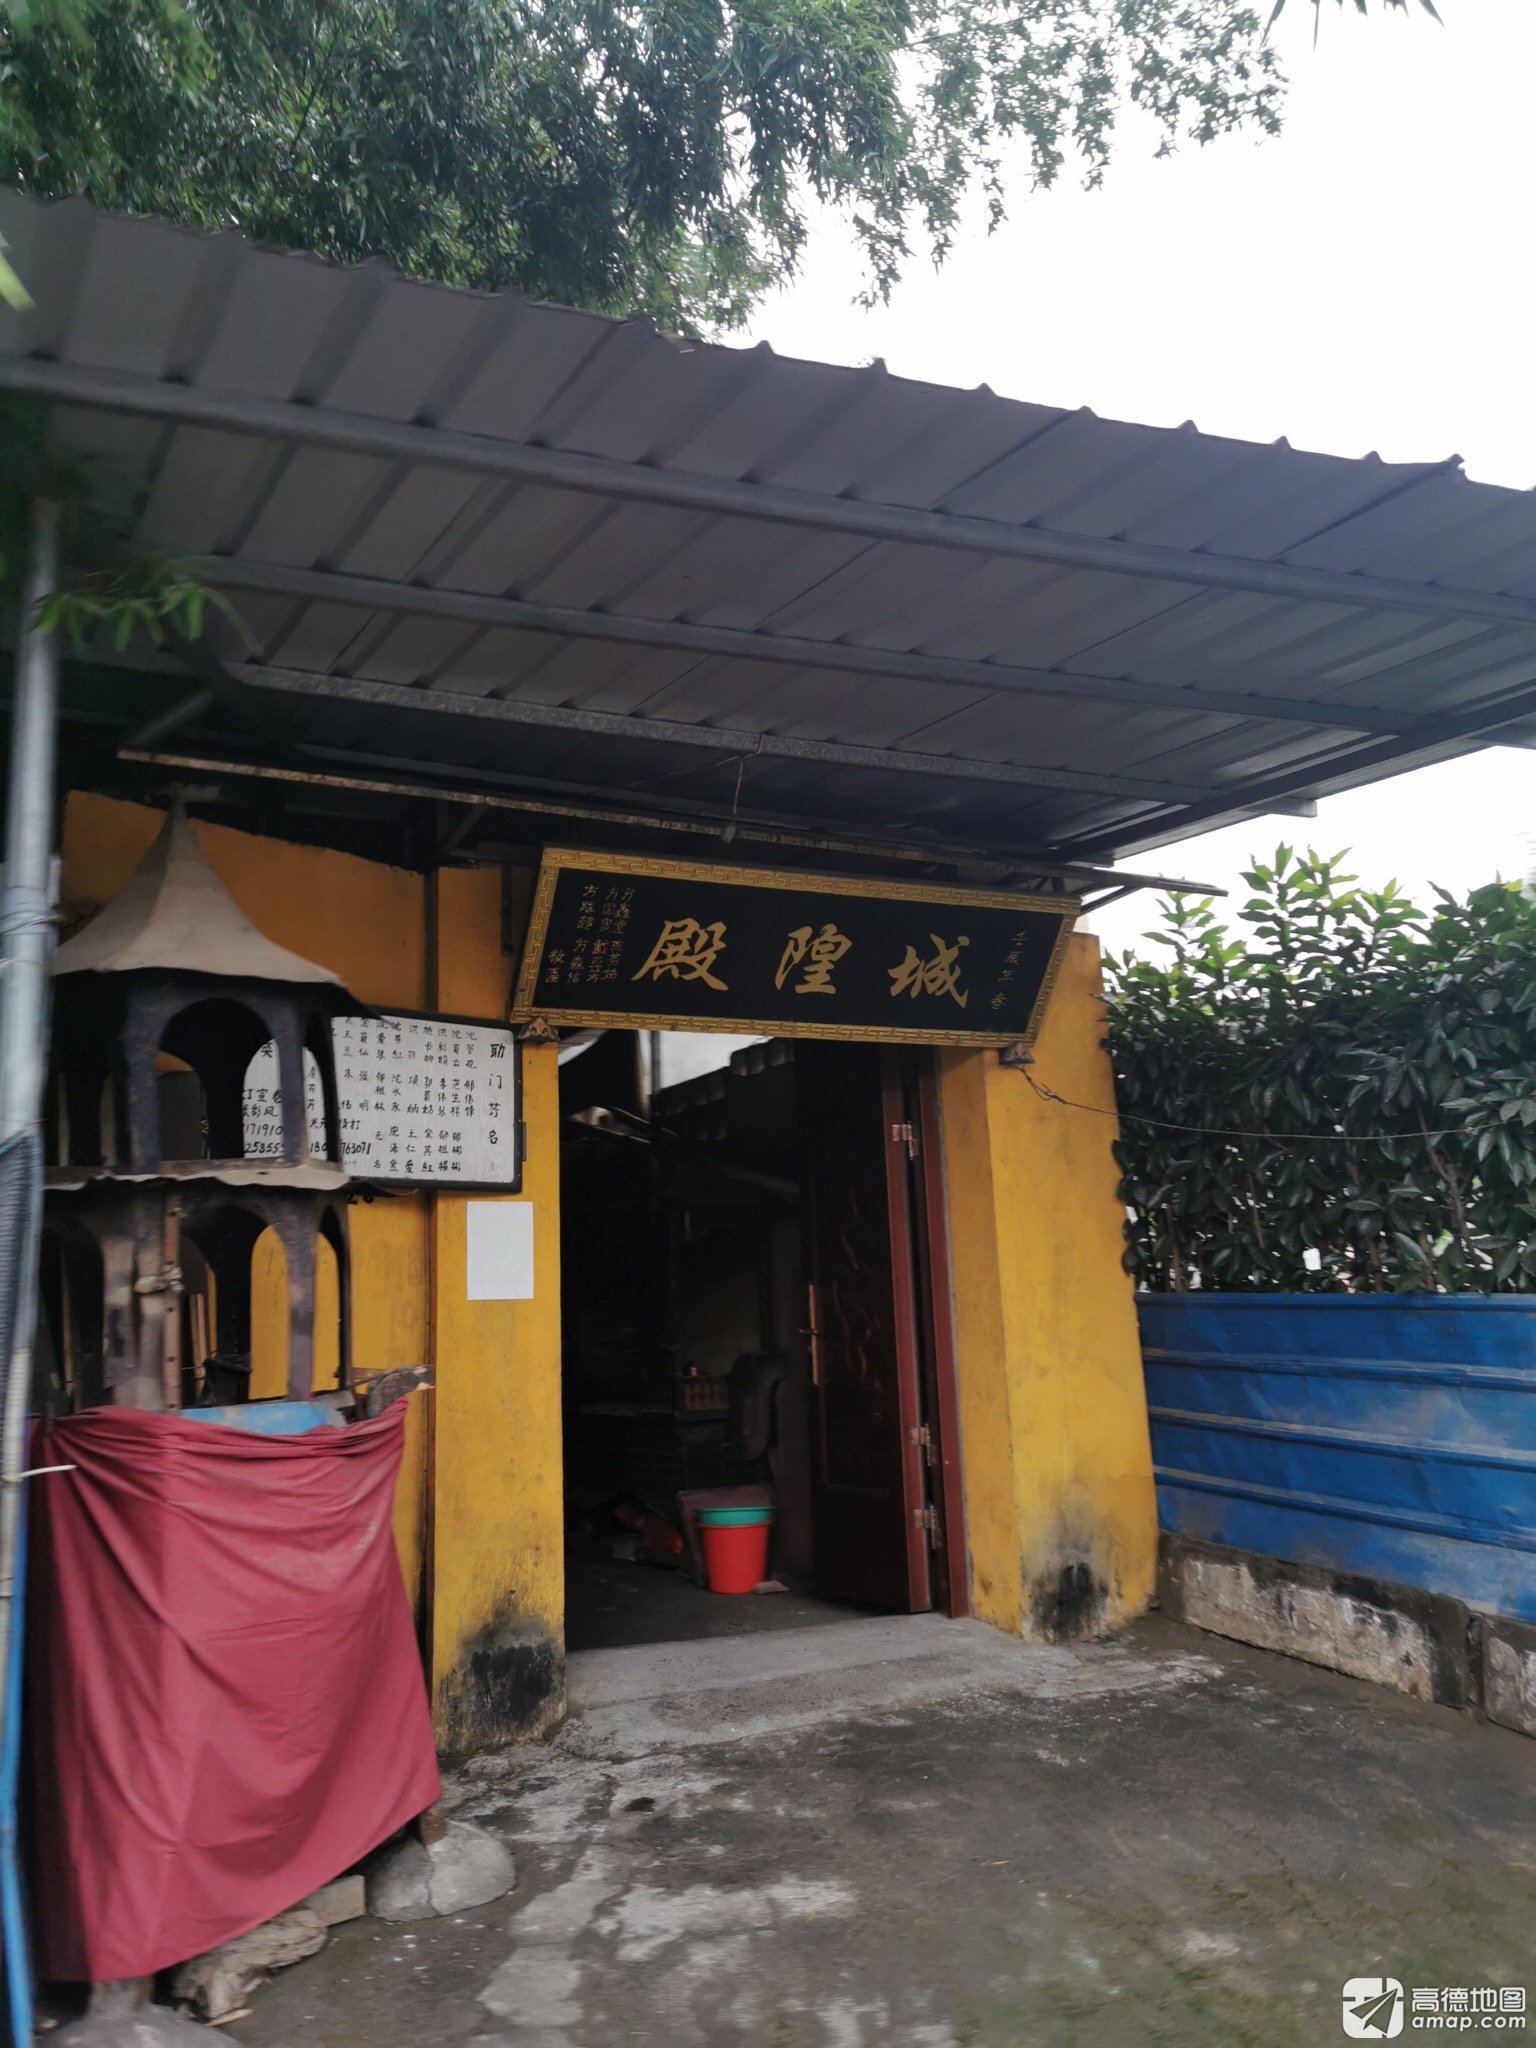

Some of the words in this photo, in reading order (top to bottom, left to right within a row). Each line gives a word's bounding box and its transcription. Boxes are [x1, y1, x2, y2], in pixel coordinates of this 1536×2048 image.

[631, 916, 971, 1009] 城隍殿
[487, 1043, 506, 1145] 助门芳名
